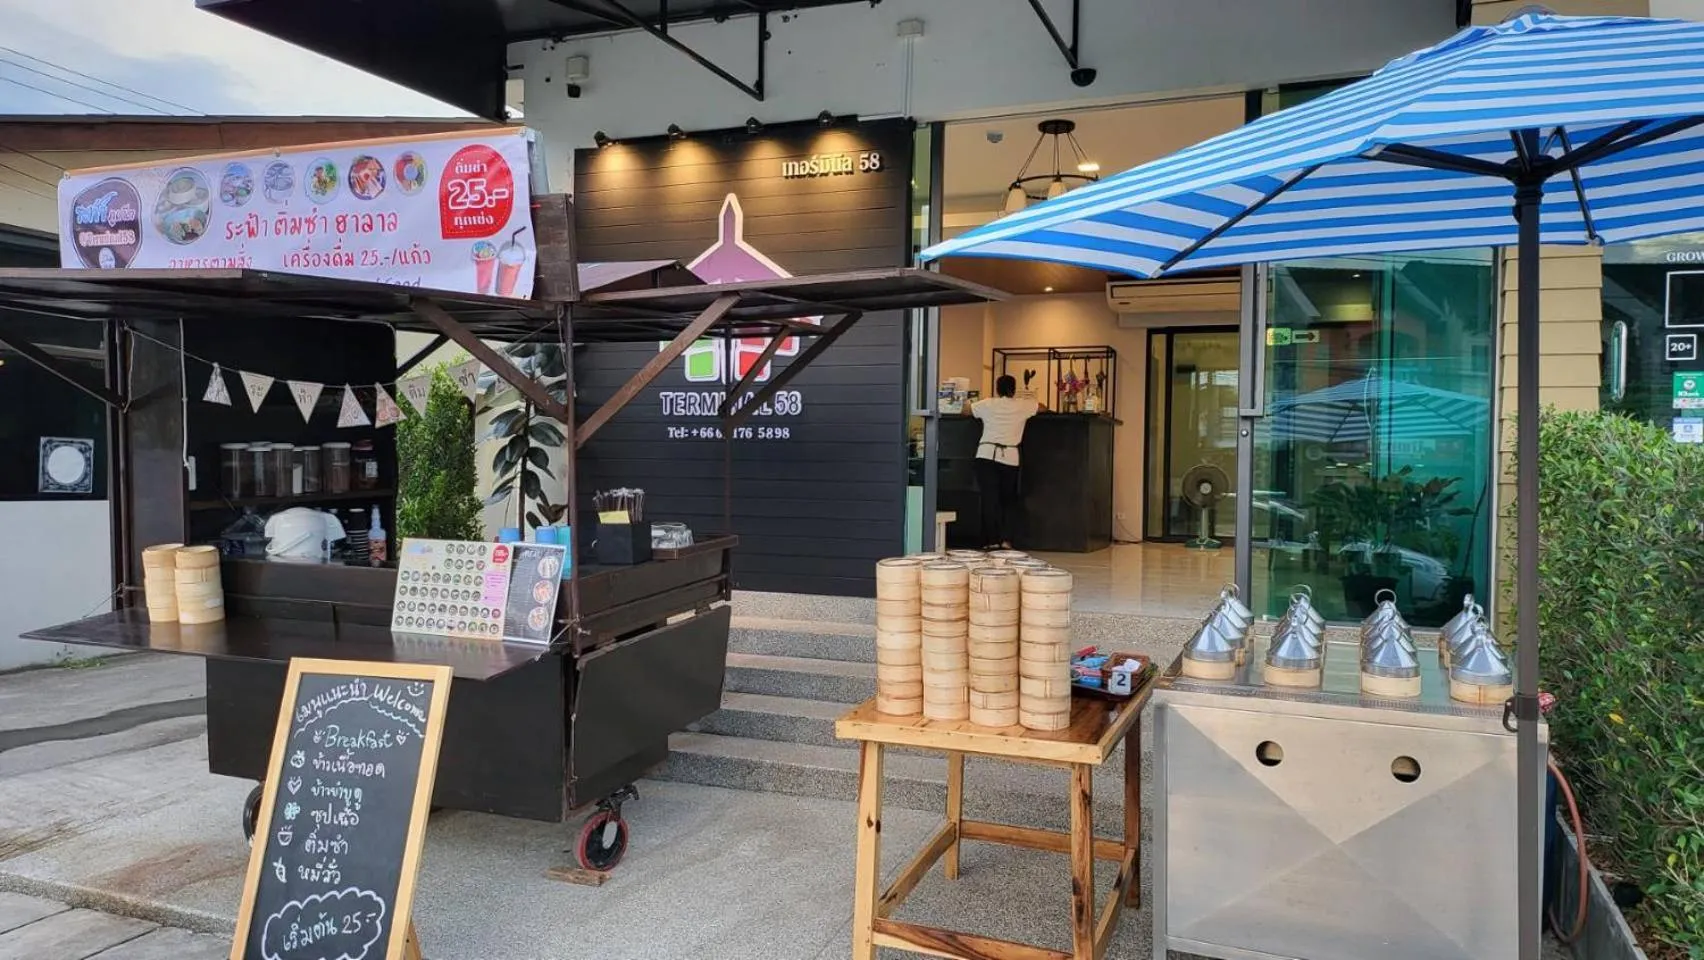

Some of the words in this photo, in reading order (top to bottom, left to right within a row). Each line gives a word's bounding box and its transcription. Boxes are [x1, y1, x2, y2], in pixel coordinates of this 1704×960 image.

[781, 153, 854, 176] เทอร์มินัล
[859, 152, 881, 171] 58
[447, 177, 509, 209] 25.-
[225, 211, 268, 240] ระฟ้า
[274, 200, 328, 236] ติ่มซำ
[335, 211, 398, 234] ฮาลาล
[283, 237, 354, 267] เครื่องดื่ม
[1670, 342, 1693, 353] 20+
[757, 426, 791, 439] 5898
[1116, 673, 1127, 687] 2
[295, 678, 368, 723] เมนูแนะนำ
[372, 684, 427, 723] Welcome
[324, 724, 394, 749] Breakfast
[312, 749, 386, 778] ข้าวเนื้อทอด
[304, 823, 349, 855] ติ่มซำ
[283, 912, 338, 951] เริ่มต้น
